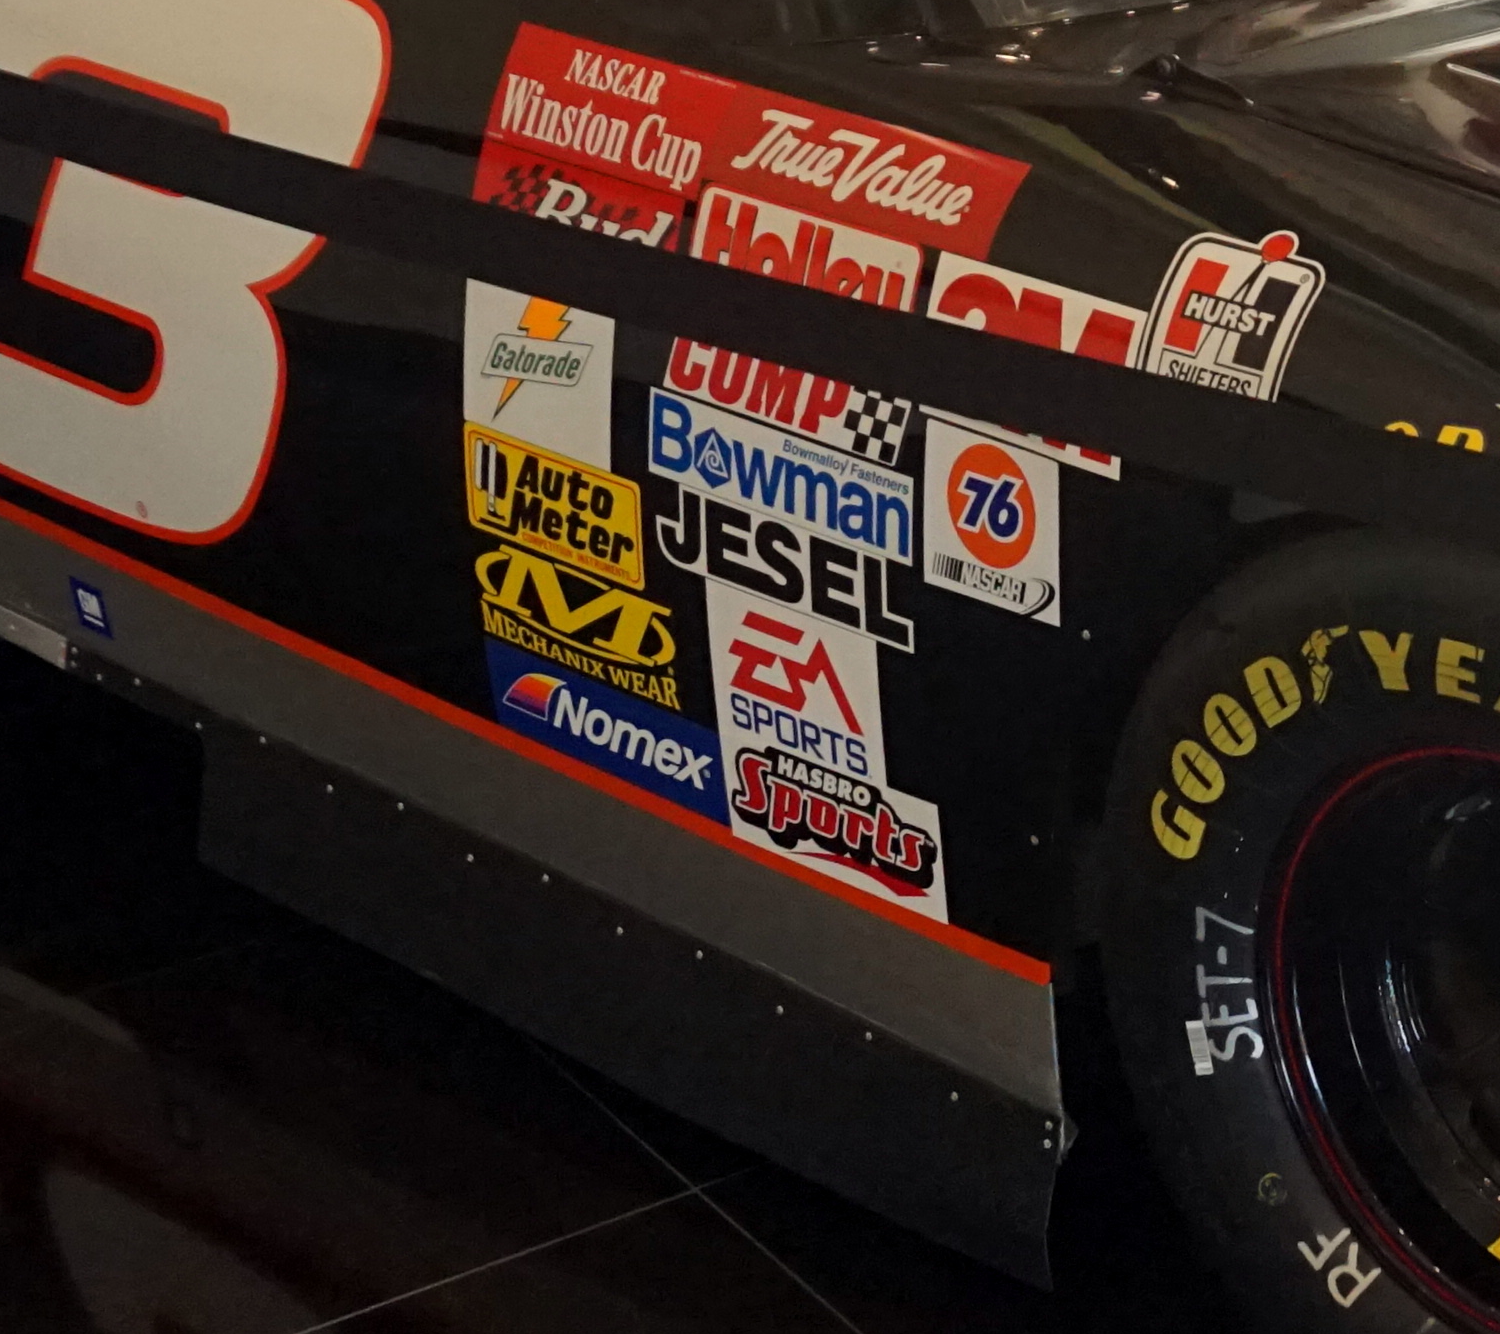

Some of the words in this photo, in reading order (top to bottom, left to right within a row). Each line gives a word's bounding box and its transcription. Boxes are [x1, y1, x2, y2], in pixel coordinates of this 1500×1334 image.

[564, 48, 667, 106] NASCAR
[500, 72, 630, 164] Winston
[630, 112, 703, 193] Cup
[1184, 291, 1276, 338] HURST
[490, 341, 582, 380] Gatorade
[1167, 358, 1254, 397] SHIFTERS
[515, 454, 615, 520] Auto
[652, 392, 910, 558] Bowman
[851, 462, 910, 496] Fasteners
[956, 473, 1024, 545] 76
[510, 488, 635, 565] Meter
[658, 486, 913, 653] JESEL
[959, 561, 1026, 606] NASCAR
[480, 599, 606, 681] MECHANIX
[608, 665, 683, 712] WEAR
[728, 610, 864, 737] EA
[553, 688, 714, 791] Nomex
[730, 692, 869, 778] SPORTS
[735, 751, 927, 873] Sports
[777, 753, 872, 807] HASBRO
[1196, 905, 1264, 1061] SET-7
[1297, 1227, 1383, 1309] RF
